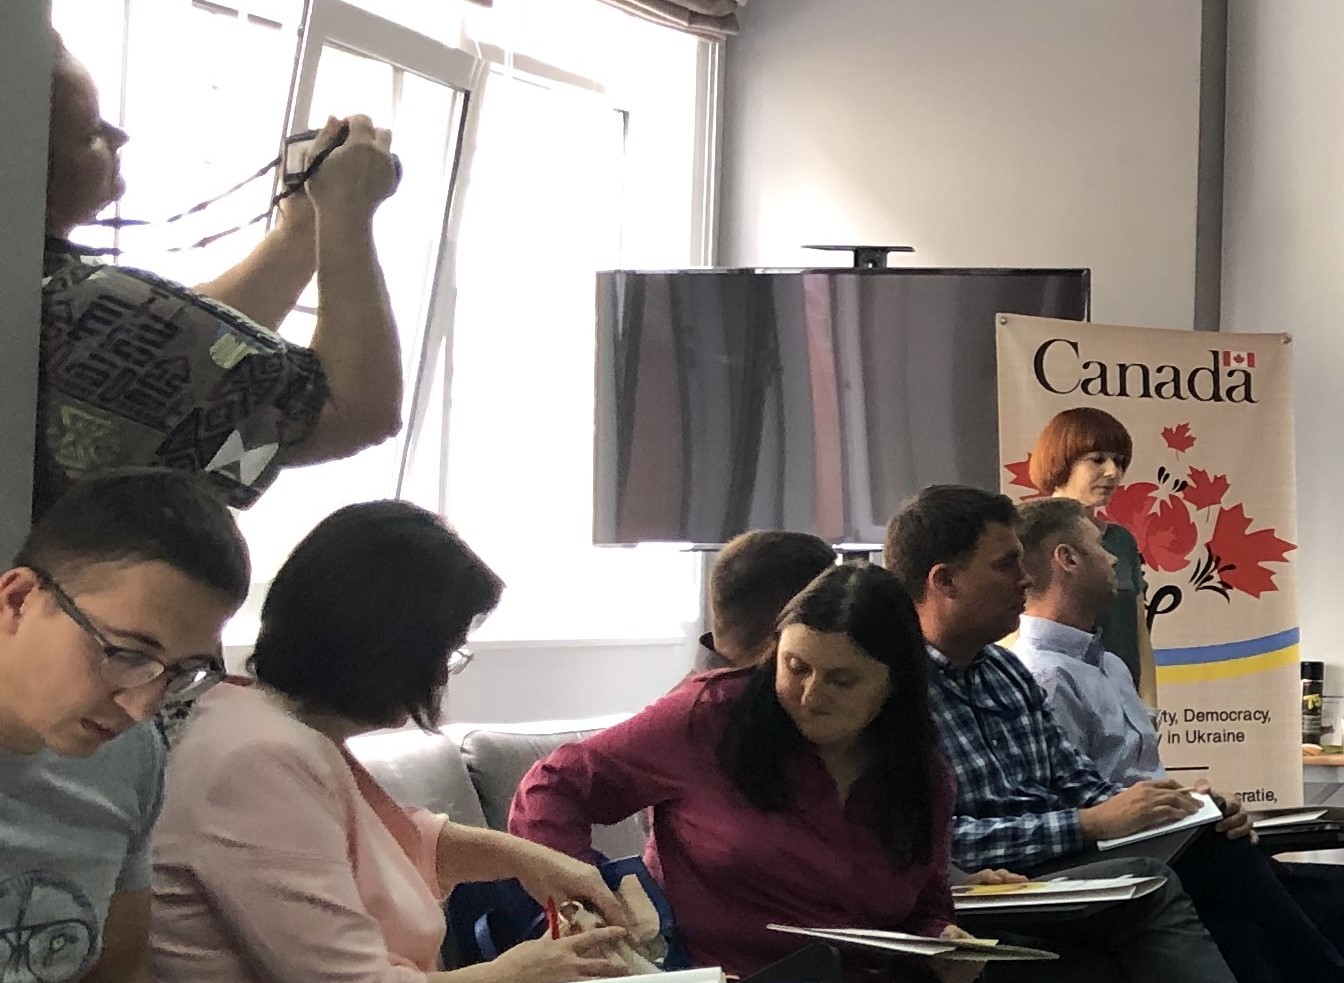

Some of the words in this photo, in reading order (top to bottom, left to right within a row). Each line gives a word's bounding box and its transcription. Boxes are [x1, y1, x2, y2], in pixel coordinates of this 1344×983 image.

[1033, 337, 1260, 404] Canada
[1183, 708, 1272, 725] Democracy,
[1166, 730, 1181, 744] in
[1185, 728, 1246, 744] Ukraine
